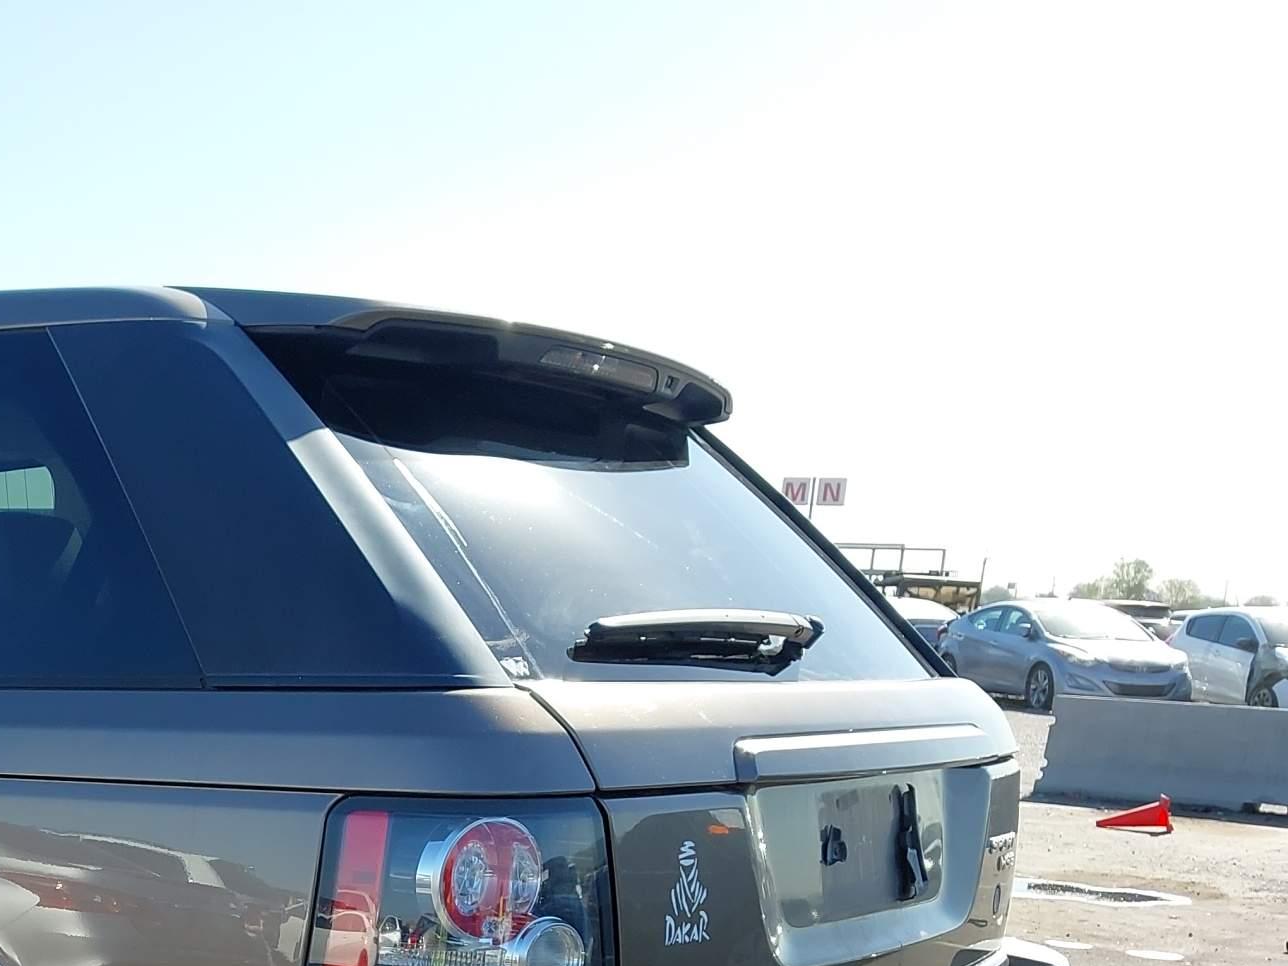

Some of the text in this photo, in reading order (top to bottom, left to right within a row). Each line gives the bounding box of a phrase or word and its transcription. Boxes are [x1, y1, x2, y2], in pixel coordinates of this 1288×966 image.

[785, 482, 807, 502] M
[822, 482, 841, 502] N
[665, 910, 710, 946] DAKAR
